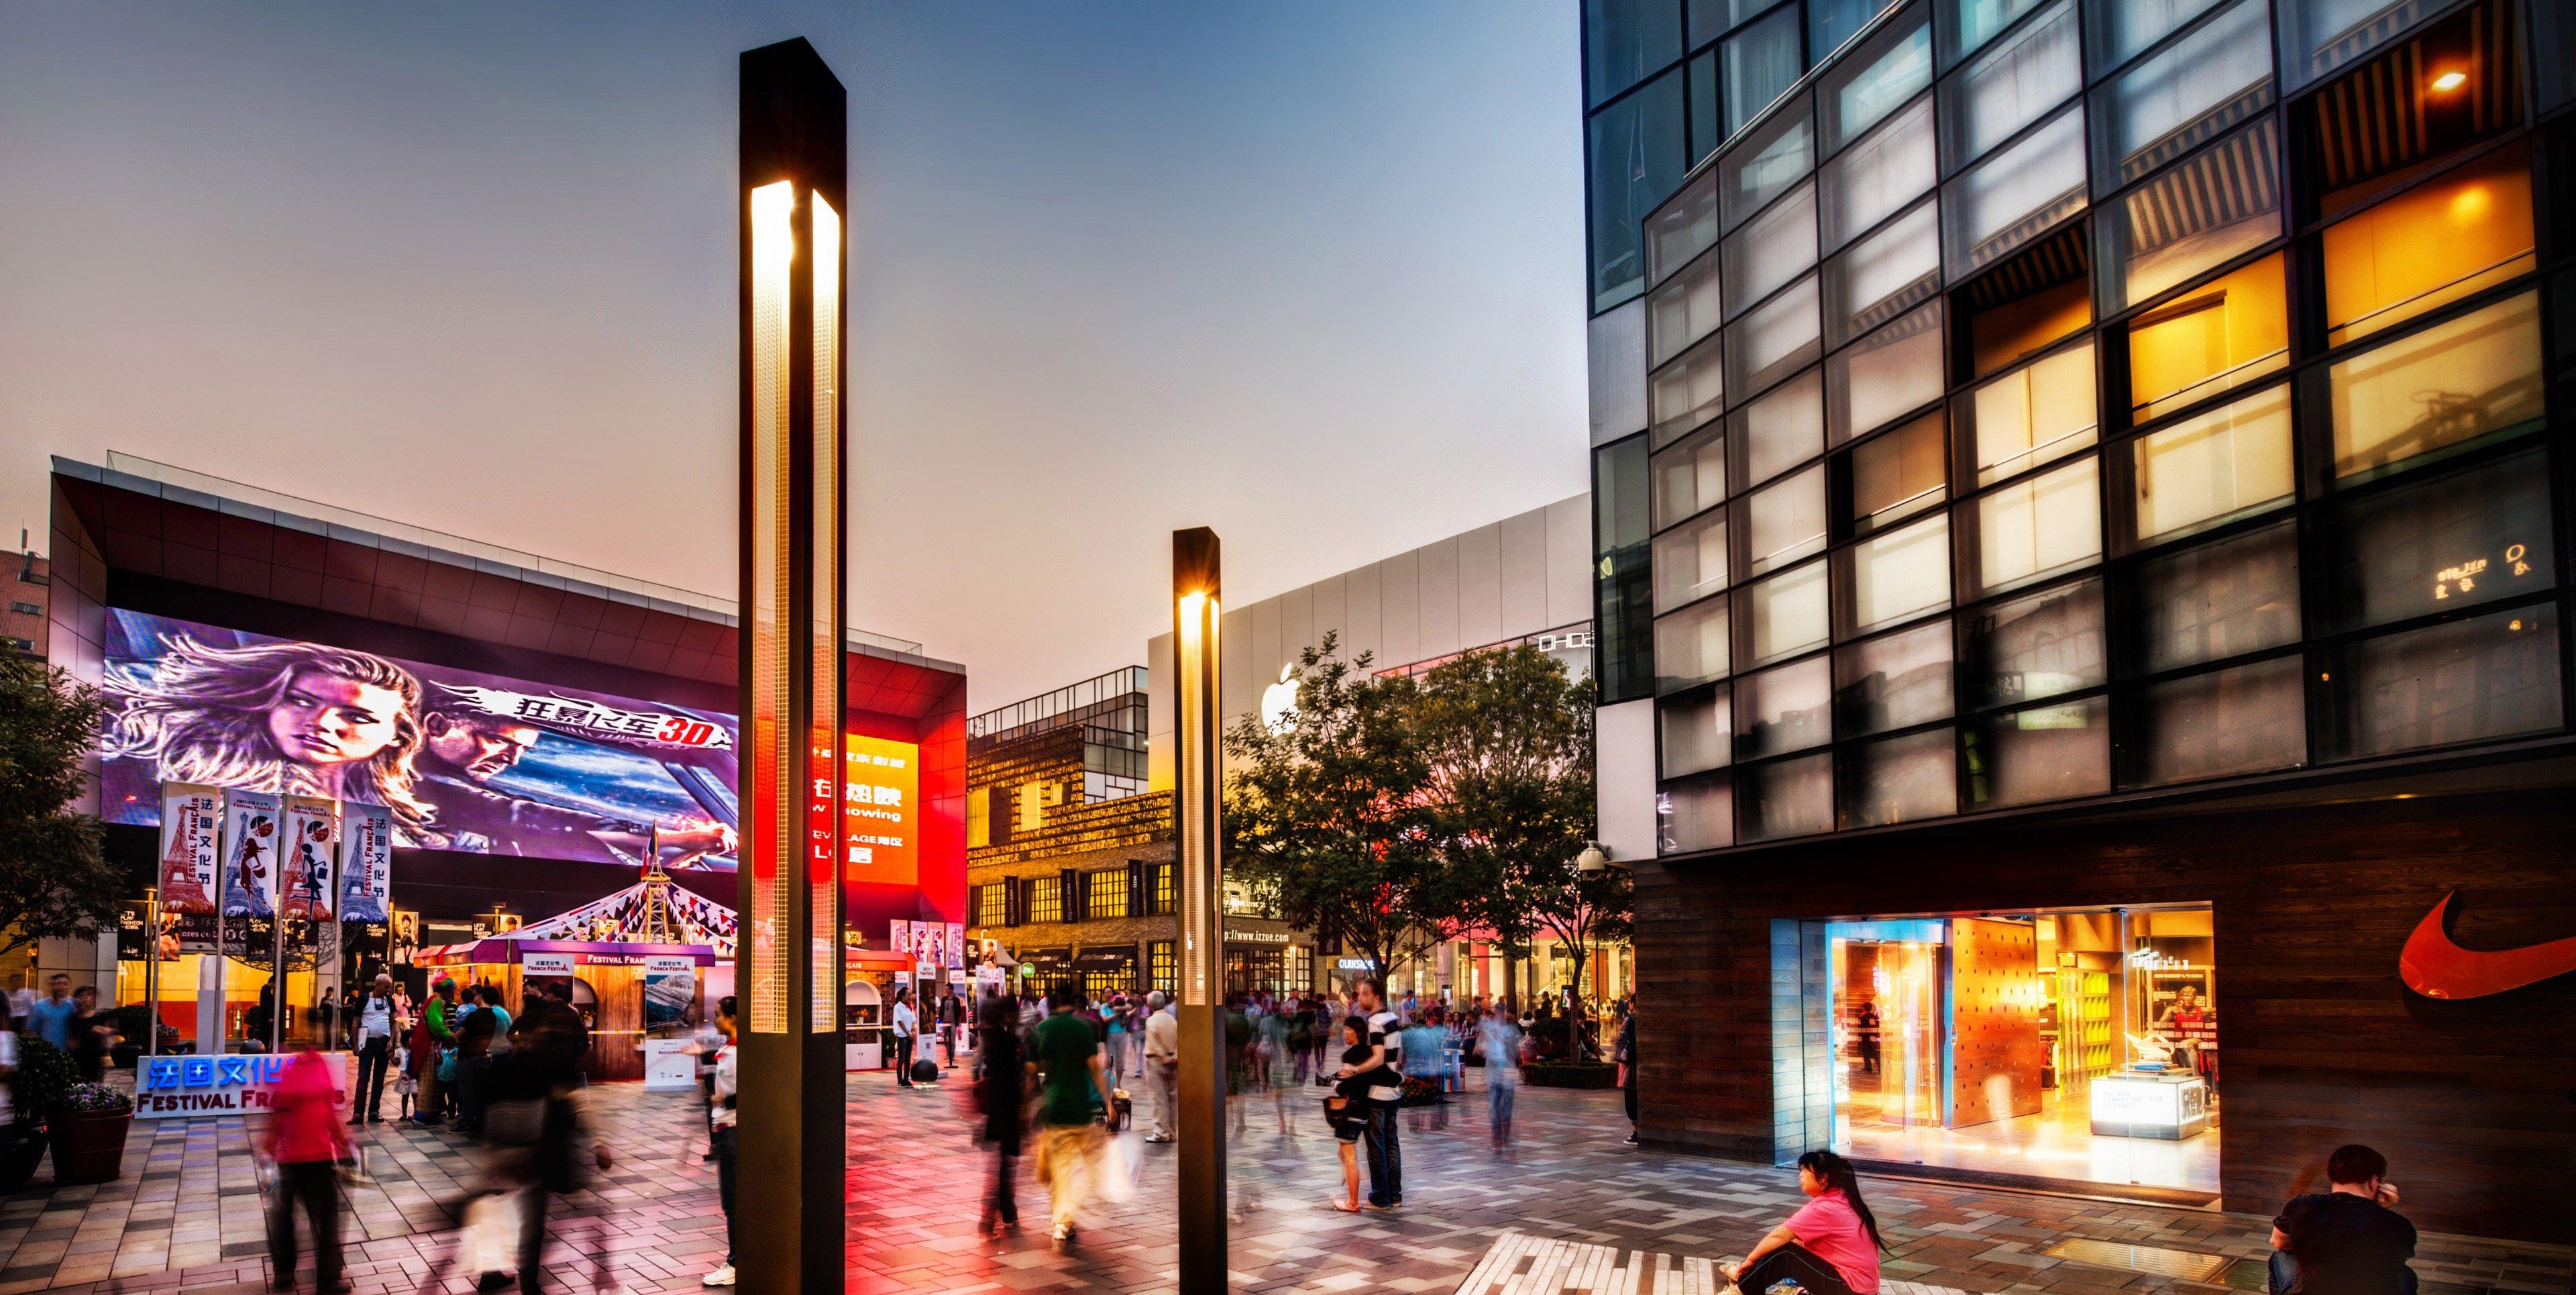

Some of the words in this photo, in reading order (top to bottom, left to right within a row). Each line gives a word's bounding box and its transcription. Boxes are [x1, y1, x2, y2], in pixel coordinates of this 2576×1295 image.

[514, 698, 658, 735] 狂暴飞车
[658, 719, 714, 745] 3D
[198, 798, 213, 885] 法国文化节
[373, 818, 387, 898] 法国文化节
[186, 843, 197, 884] FESTIVAL
[363, 860, 373, 897] FESTIVAL
[1224, 929, 1289, 942] p://www.izzue.com
[547, 964, 569, 972] FESTIVAL
[587, 954, 623, 964] FESTIVAL
[625, 955, 646, 964] FRAN
[669, 964, 690, 972] FESTIVAL
[147, 1057, 295, 1090] 法国文化
[137, 1092, 236, 1113] FESTIVAL
